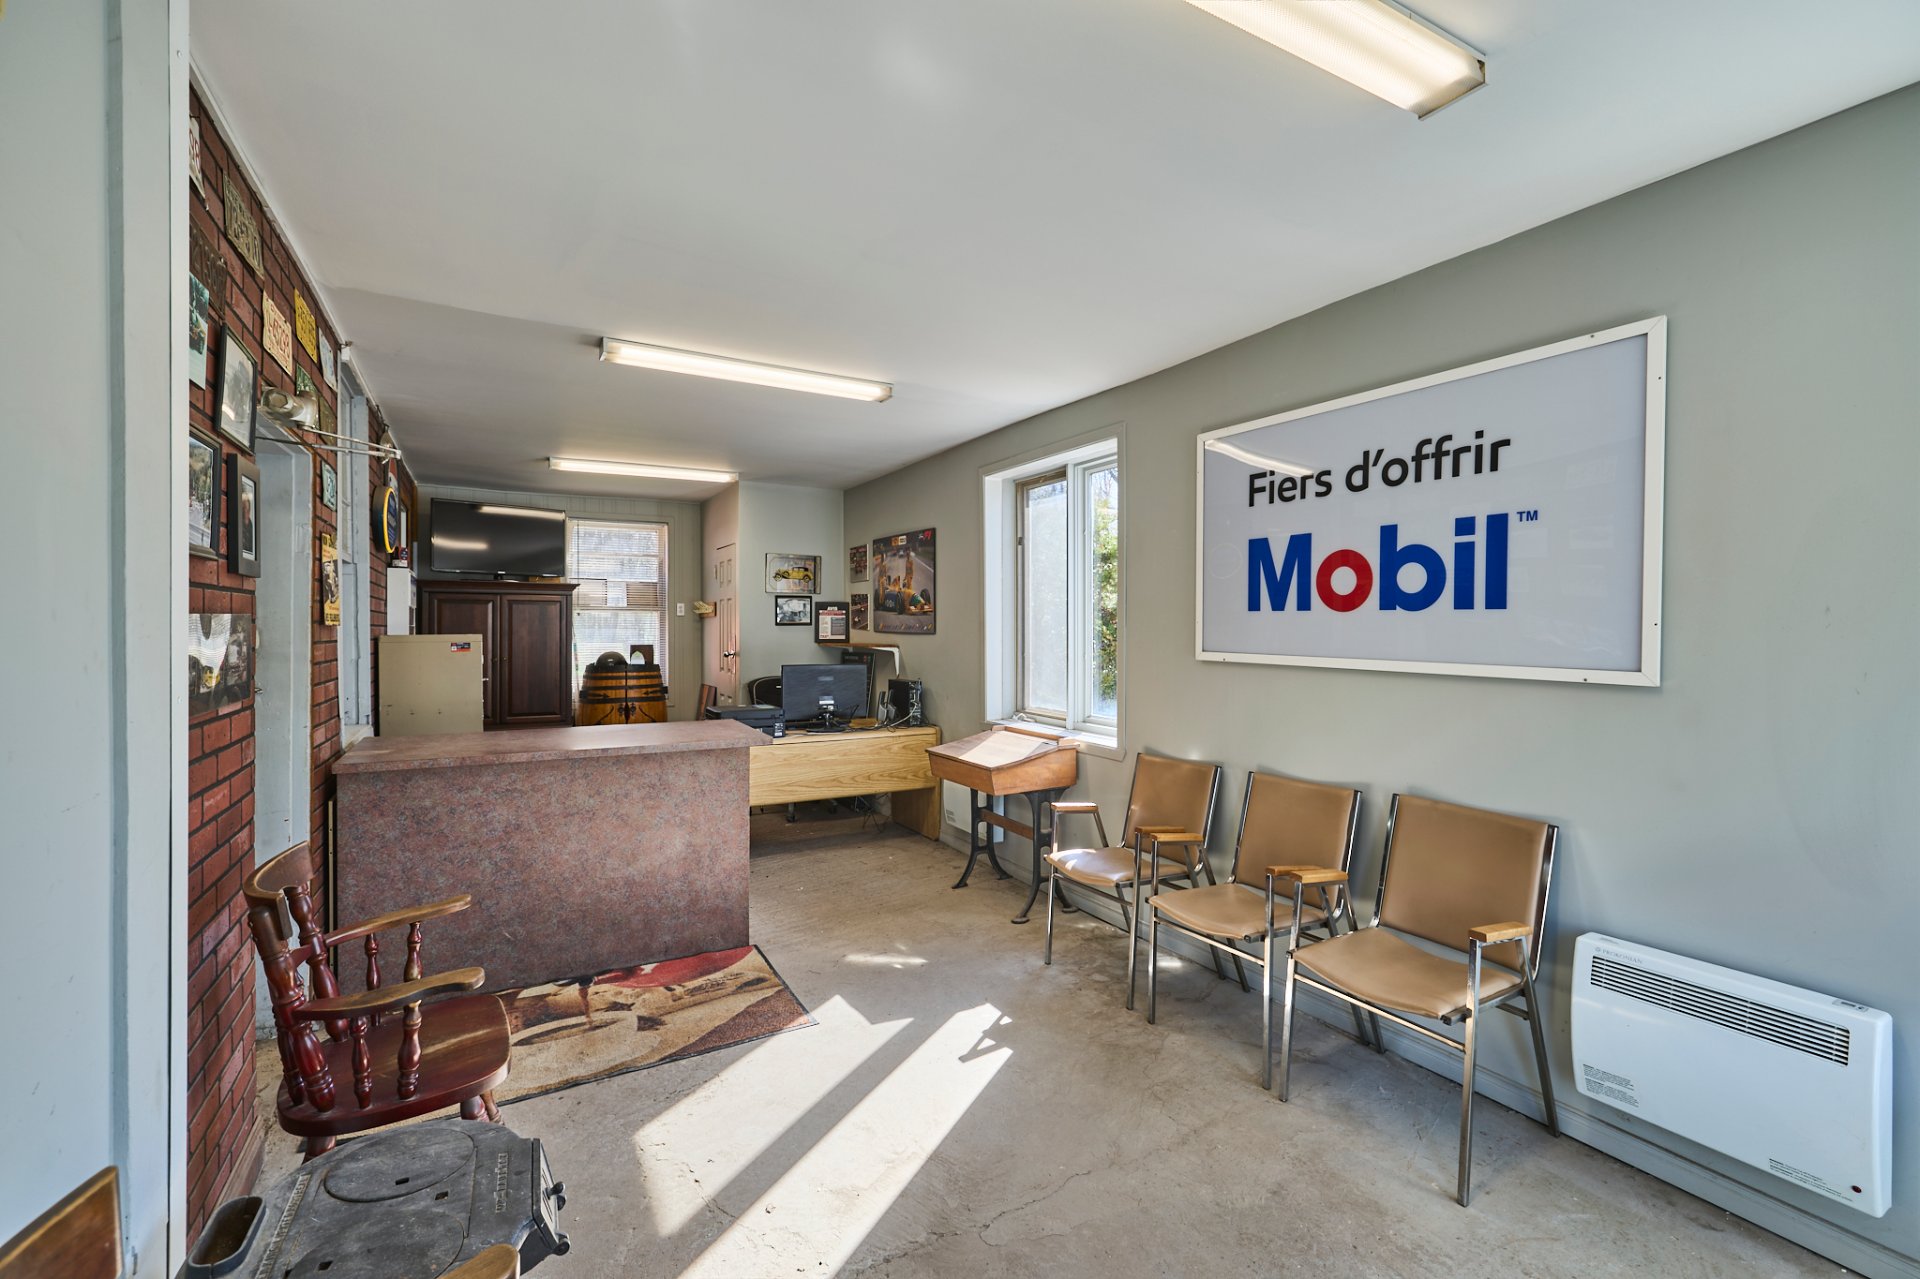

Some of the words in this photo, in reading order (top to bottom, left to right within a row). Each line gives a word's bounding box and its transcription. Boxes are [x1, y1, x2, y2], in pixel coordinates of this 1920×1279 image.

[1249, 470, 1332, 507] Fiers
[1345, 430, 1511, 492] d'offrir
[1248, 513, 1508, 612] Mobil
[1517, 510, 1538, 522] TM
